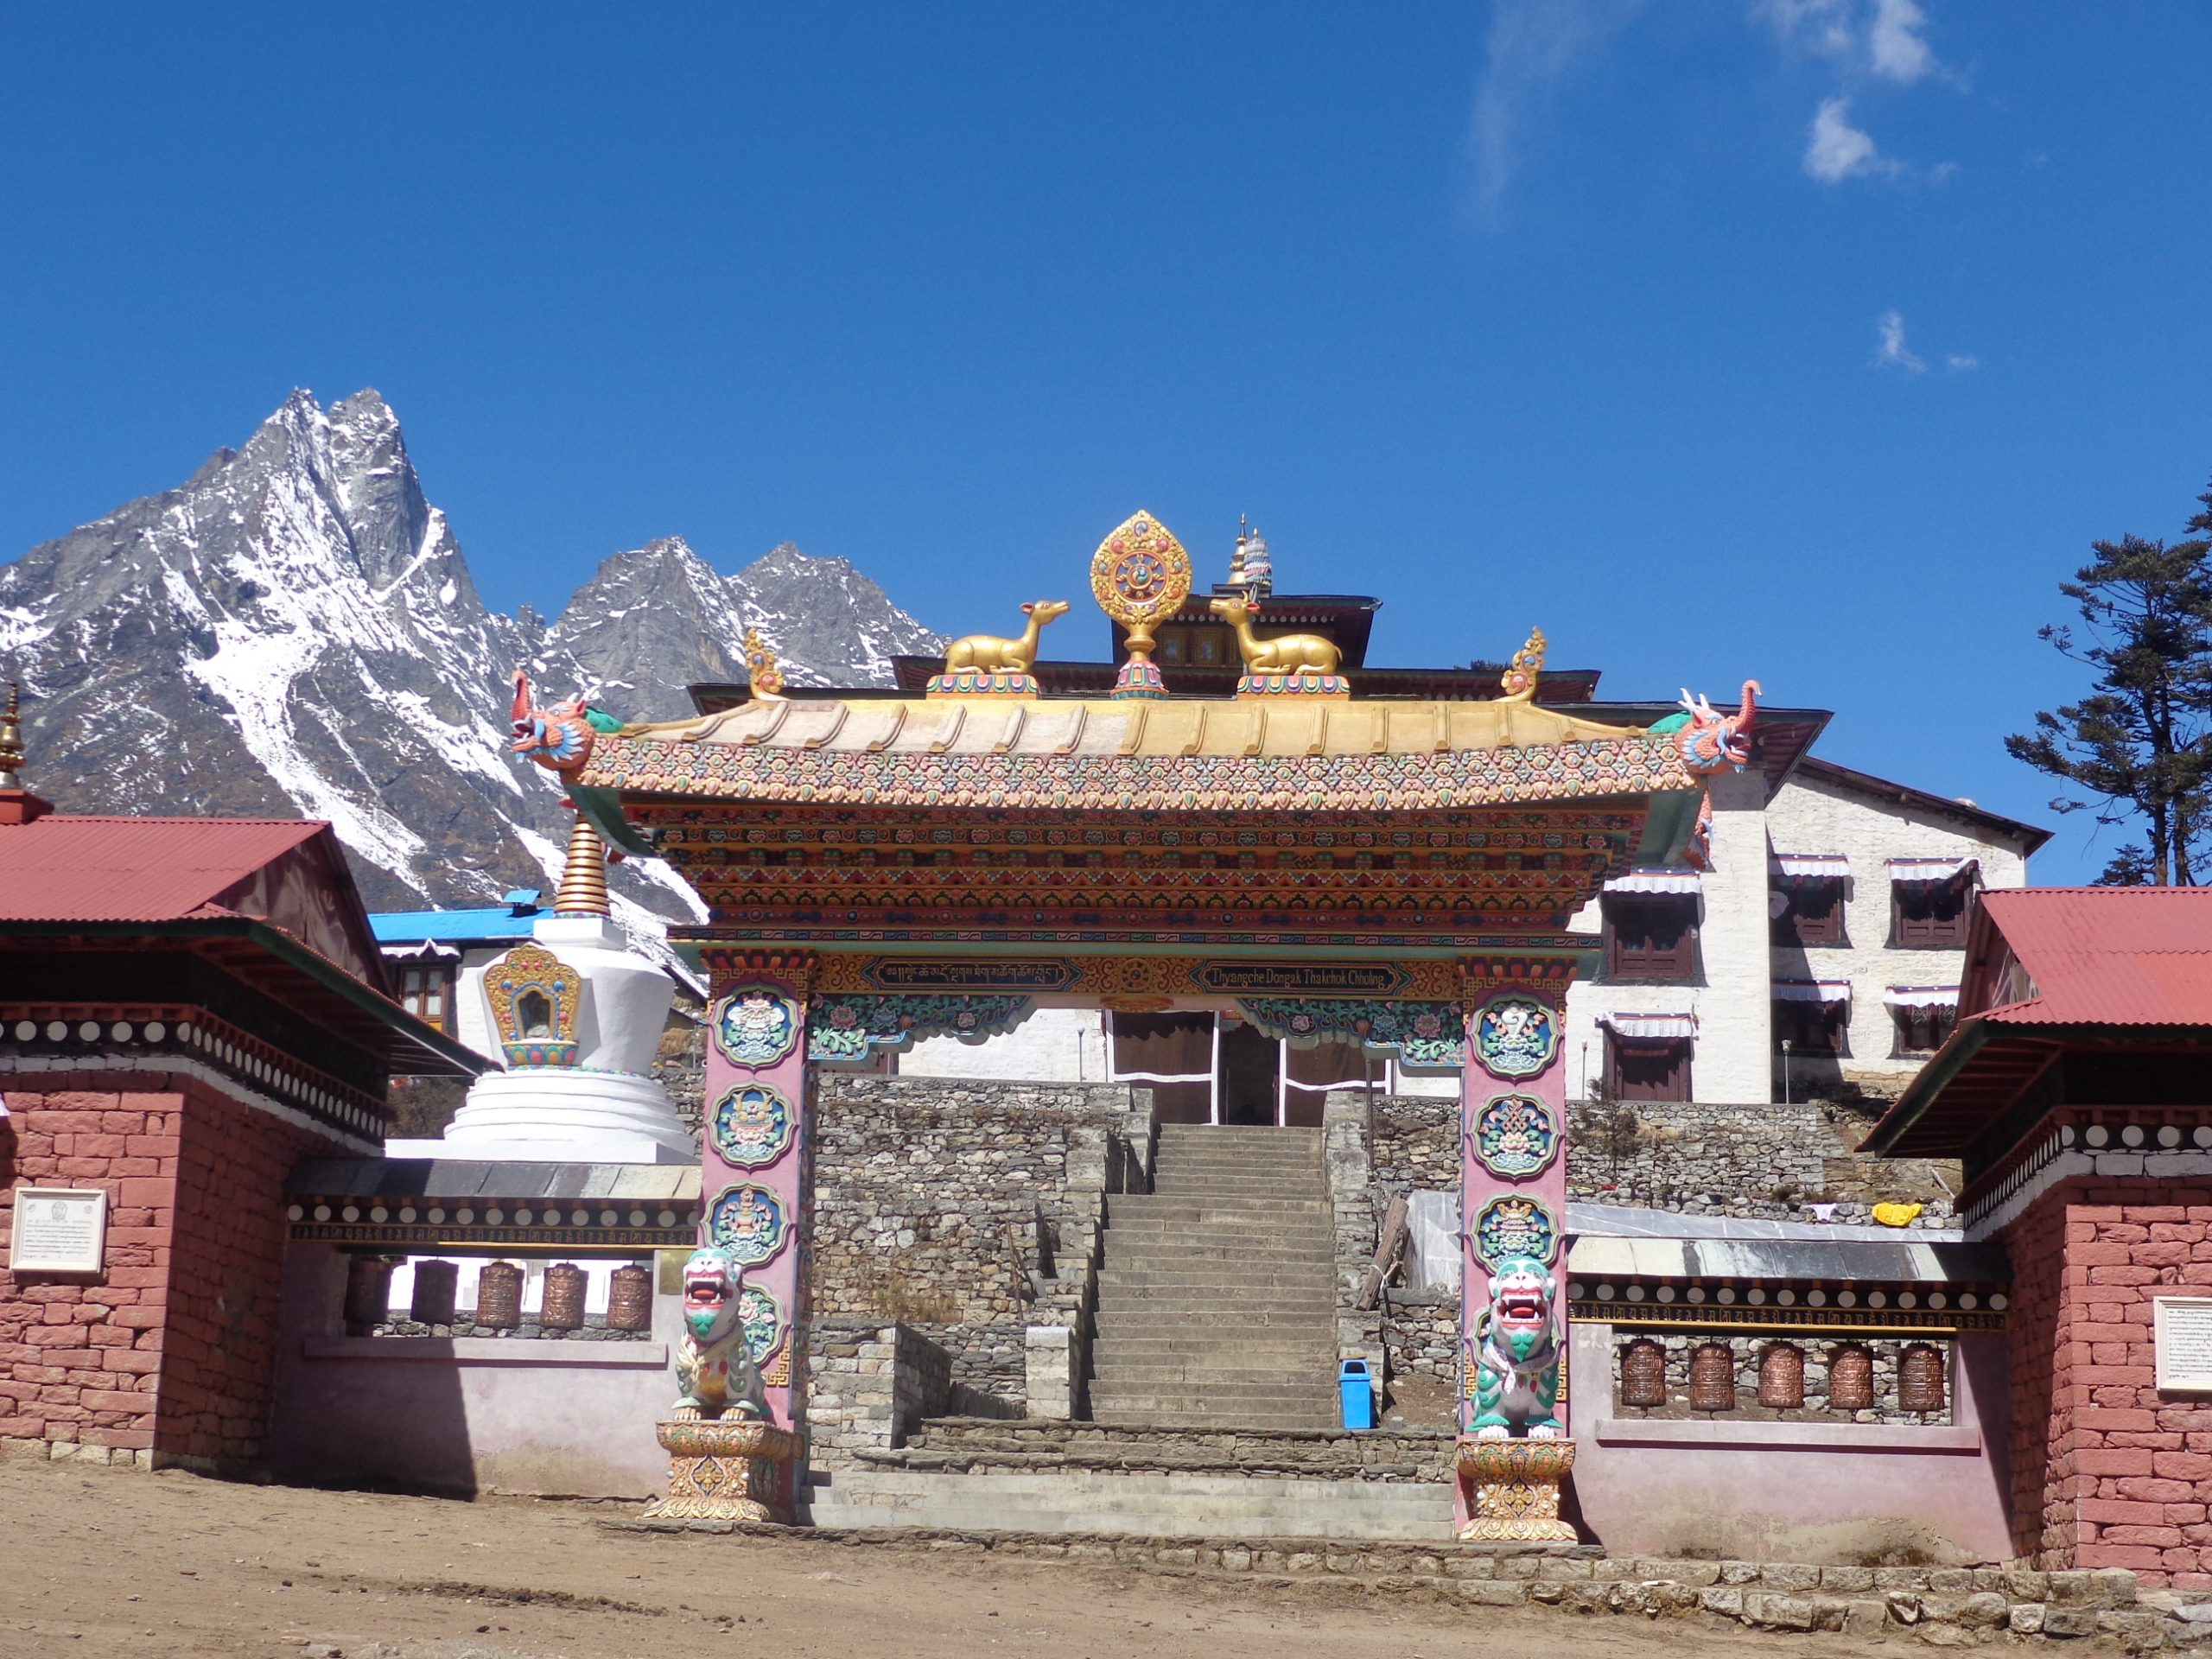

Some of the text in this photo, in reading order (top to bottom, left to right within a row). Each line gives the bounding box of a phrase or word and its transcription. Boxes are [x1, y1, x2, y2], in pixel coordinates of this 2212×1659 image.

[1213, 968, 1384, 988] Thyangche Dongak Thakchok Chholing
